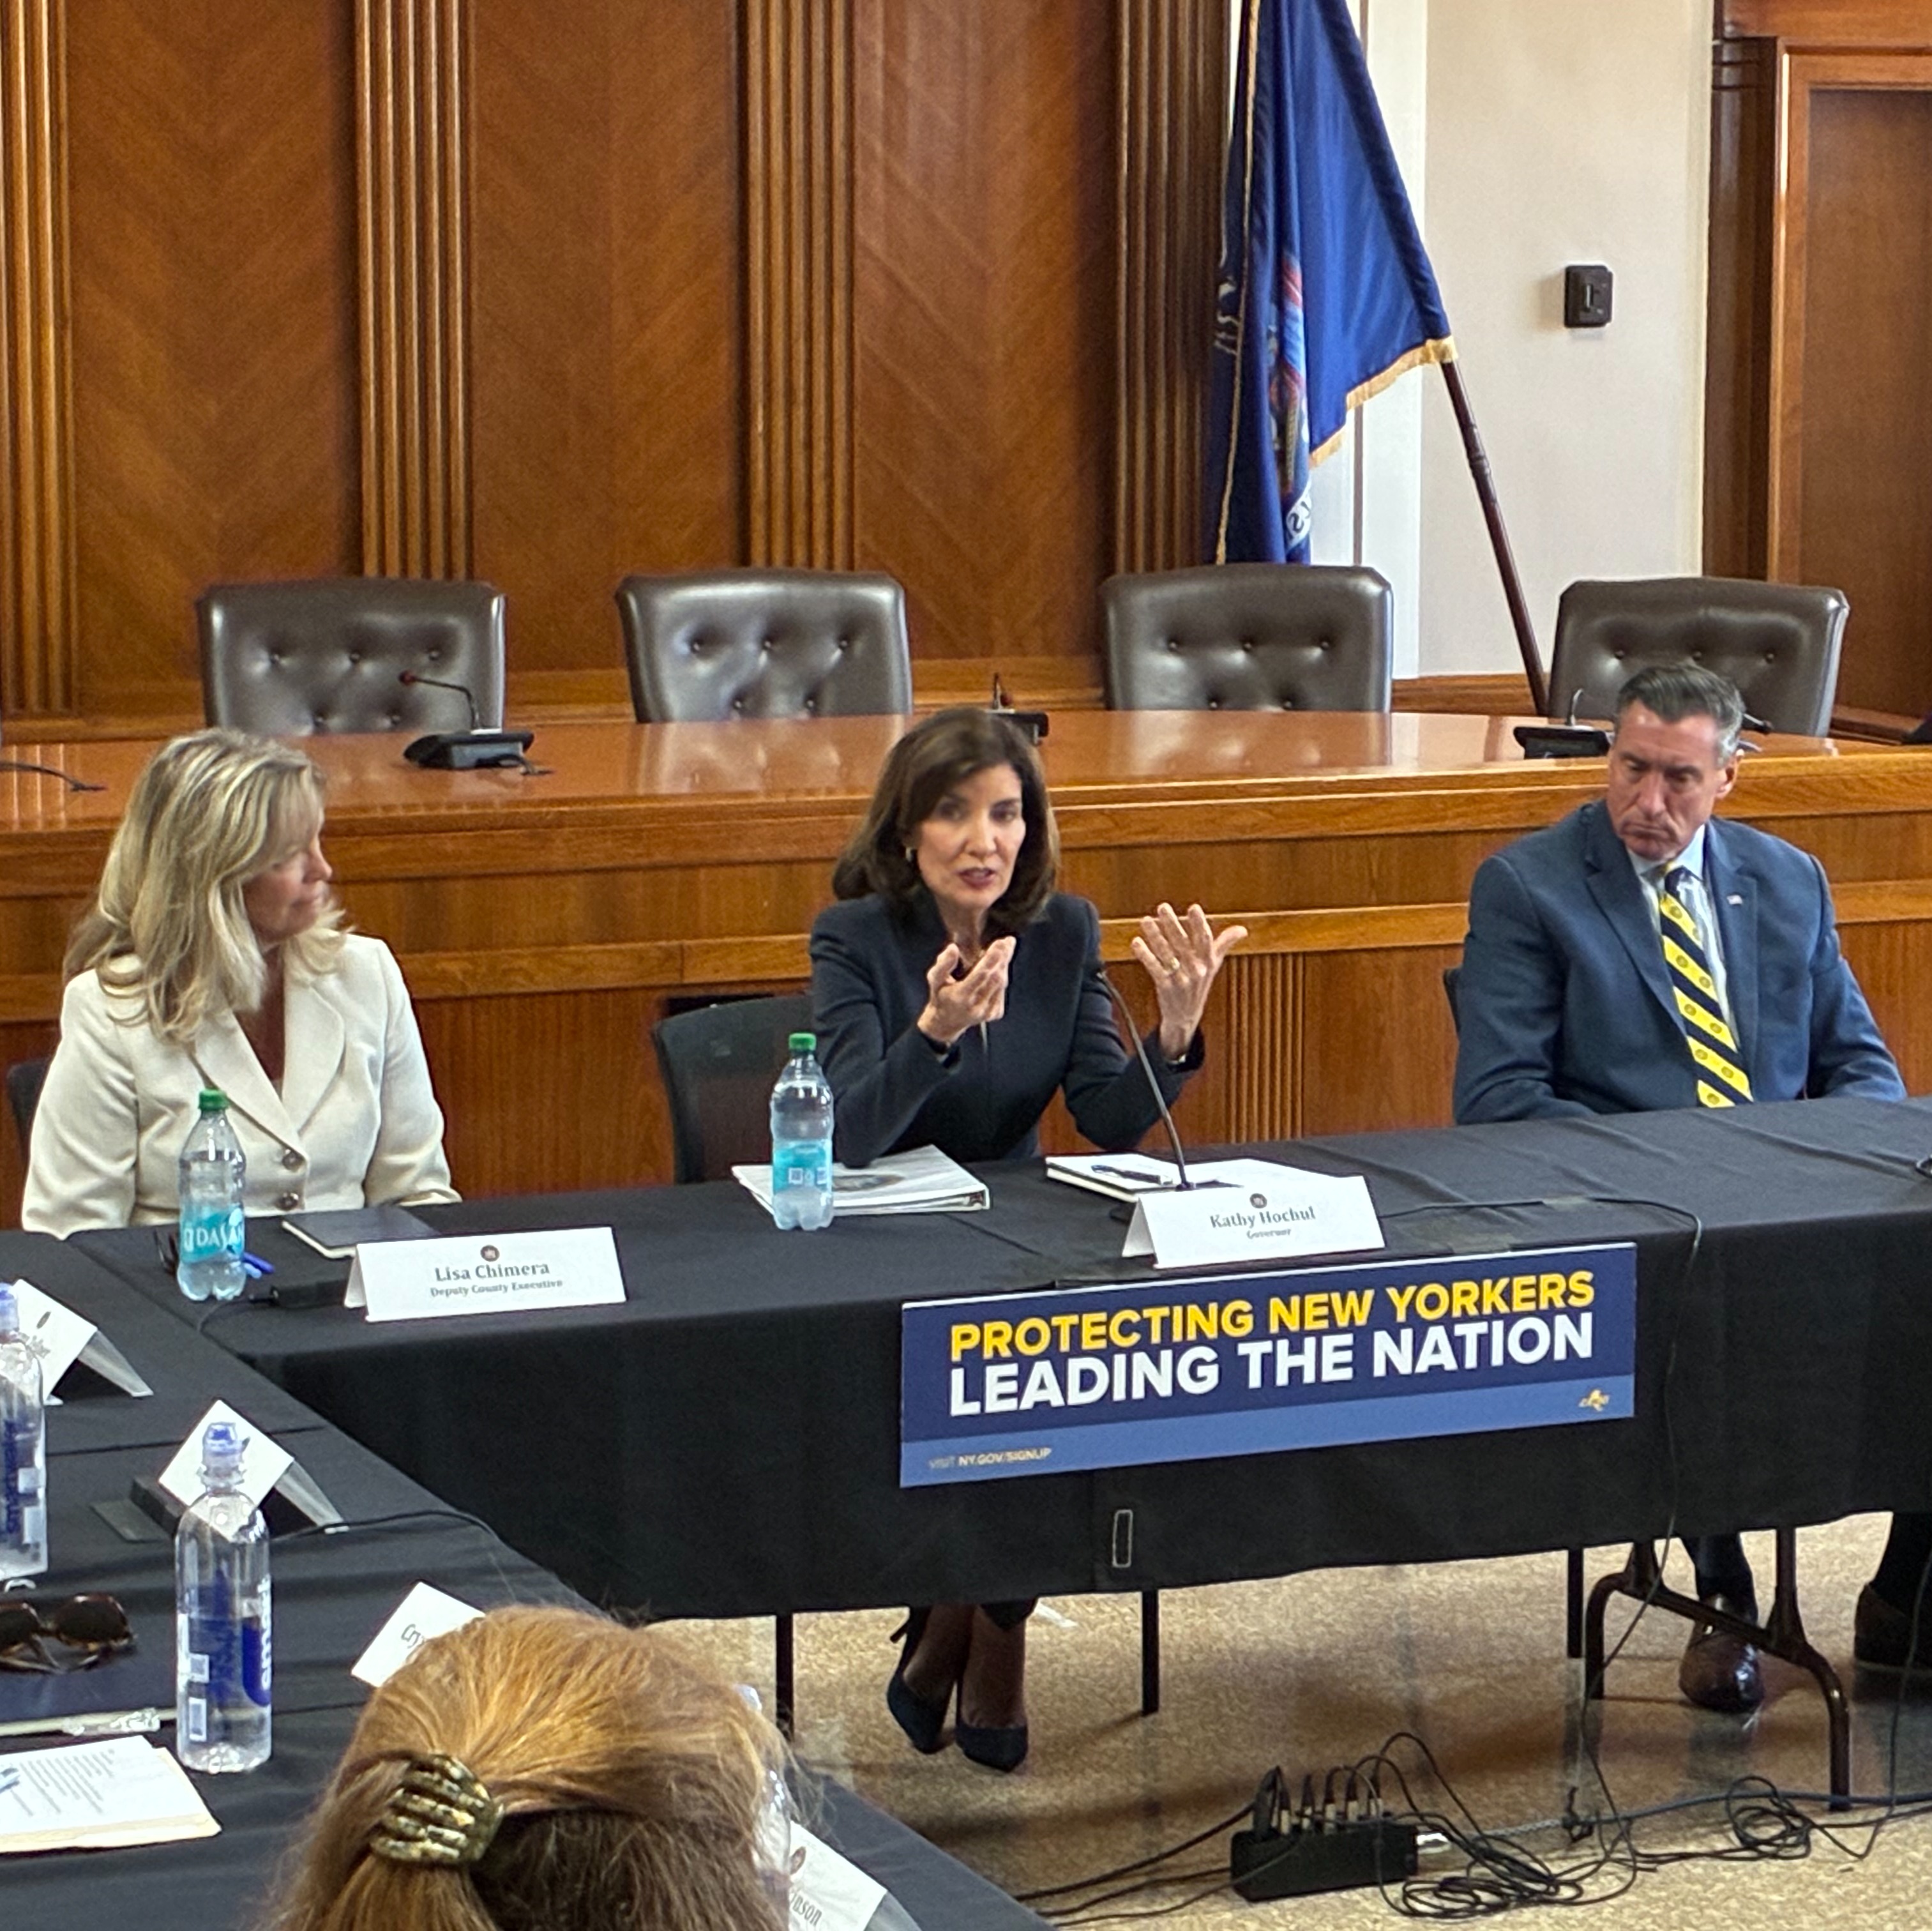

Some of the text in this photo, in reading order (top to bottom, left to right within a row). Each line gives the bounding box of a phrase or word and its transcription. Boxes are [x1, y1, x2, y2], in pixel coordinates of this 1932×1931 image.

[1211, 1206, 1316, 1229] Kathy Hochul
[1246, 1229, 1292, 1239] Governor
[435, 1263, 550, 1282] Lisa Chimera
[430, 1280, 562, 1298] Deputy County Executive
[949, 1270, 1595, 1361] PROTECTING NEW YORKERS
[949, 1312, 1593, 1417] LEADING THE NATION
